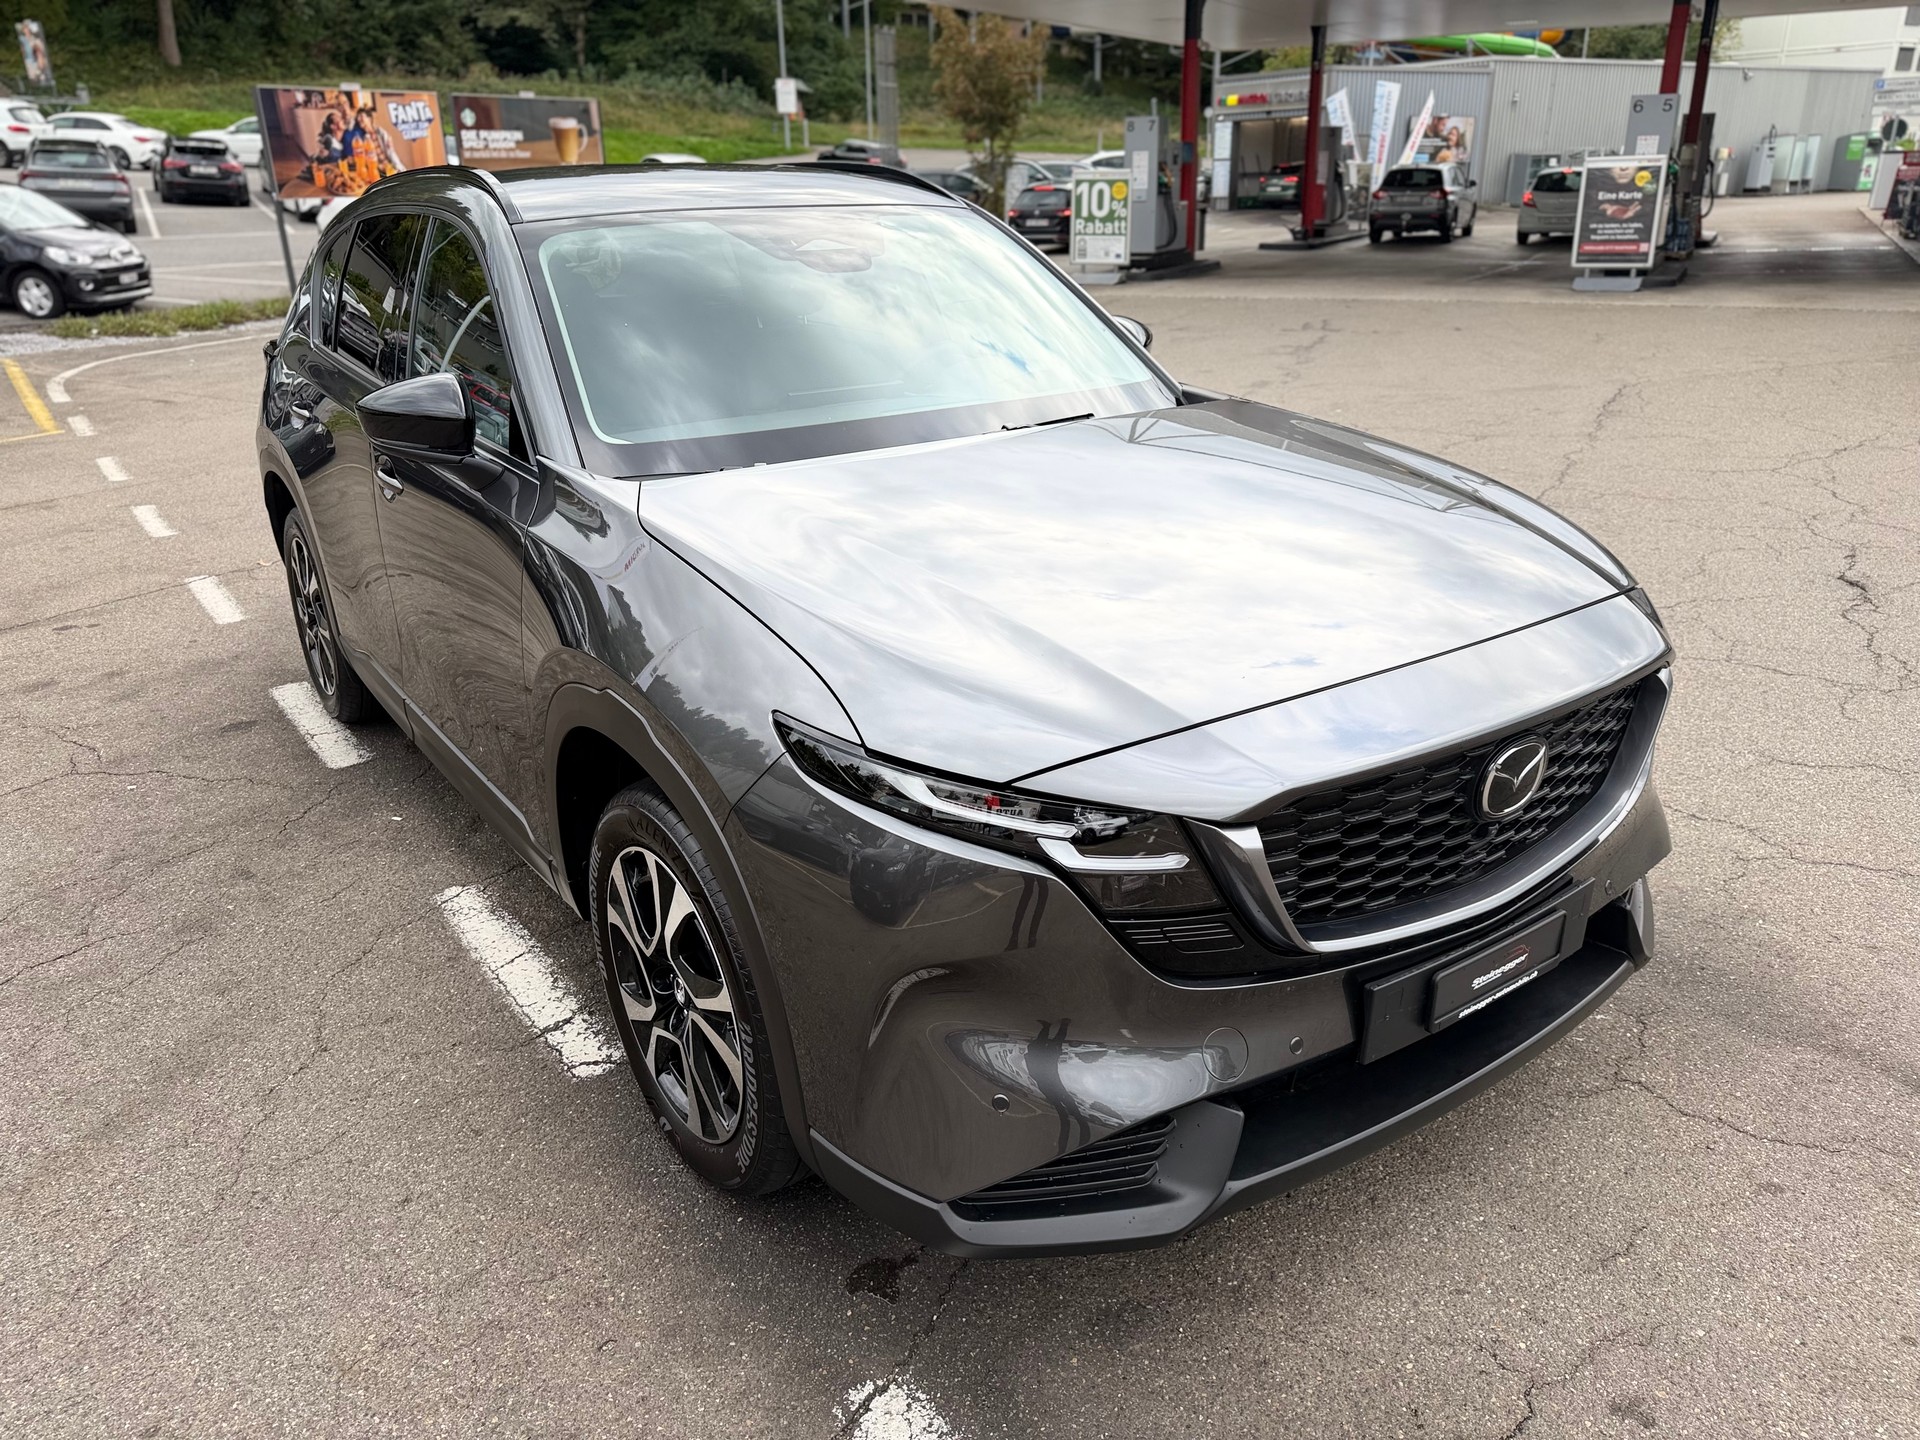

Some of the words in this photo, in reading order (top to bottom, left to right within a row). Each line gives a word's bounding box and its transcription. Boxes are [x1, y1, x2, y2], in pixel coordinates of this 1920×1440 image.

[387, 101, 434, 123] FANTA
[1633, 99, 1644, 114] 6
[1662, 98, 1673, 112] 5
[1127, 121, 1135, 132] 8
[1148, 120, 1156, 132] 7
[1598, 191, 1617, 200] Eine
[1618, 191, 1643, 200] Karte
[1075, 218, 1127, 235] Rabatt
[636, 817, 690, 882] ALENZA
[1472, 953, 1529, 988] Steinegger
[736, 1020, 759, 1175] BRIDGESTONE
